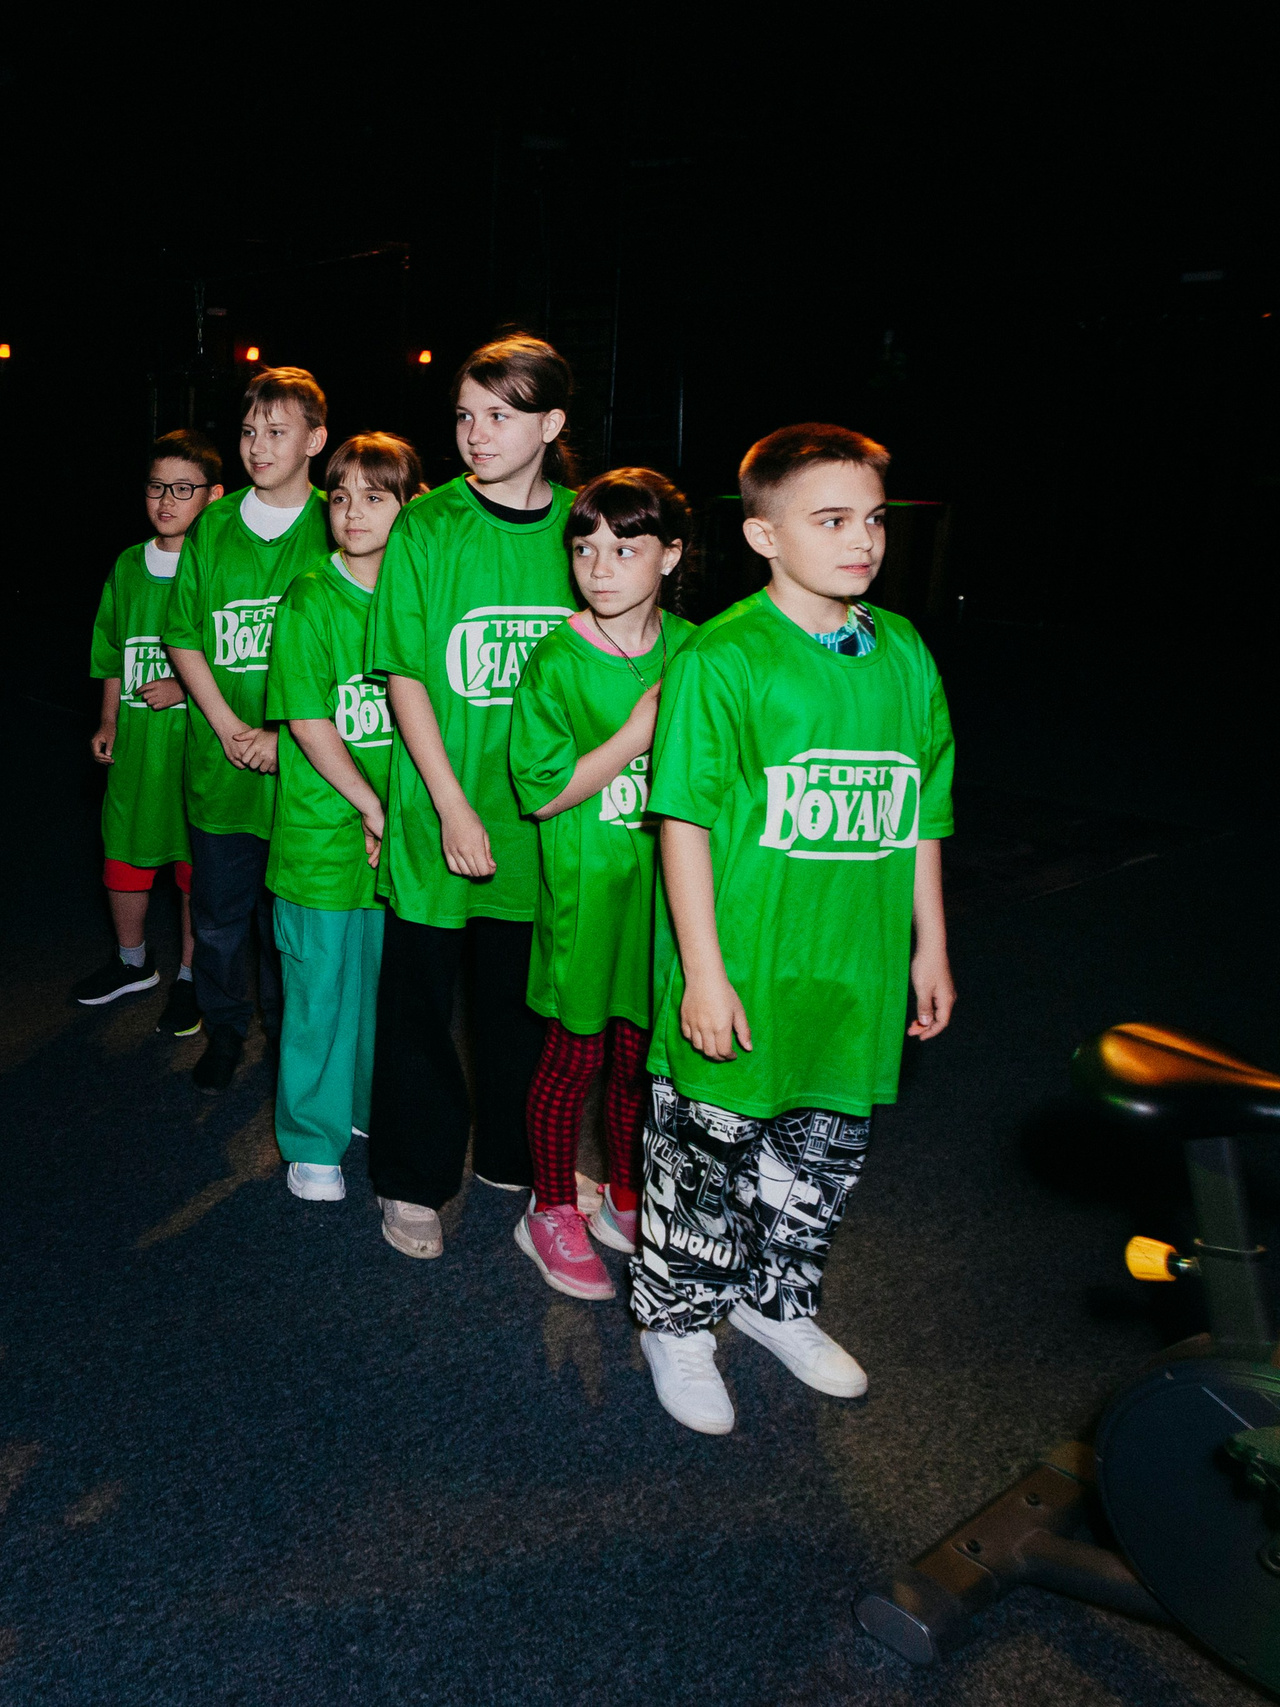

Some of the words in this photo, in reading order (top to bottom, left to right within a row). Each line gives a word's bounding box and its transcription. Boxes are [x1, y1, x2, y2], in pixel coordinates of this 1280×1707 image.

[240, 606, 276, 623] FOR
[212, 610, 273, 665] BOYA
[808, 764, 889, 786] FORT
[759, 765, 920, 850] BOYARD
